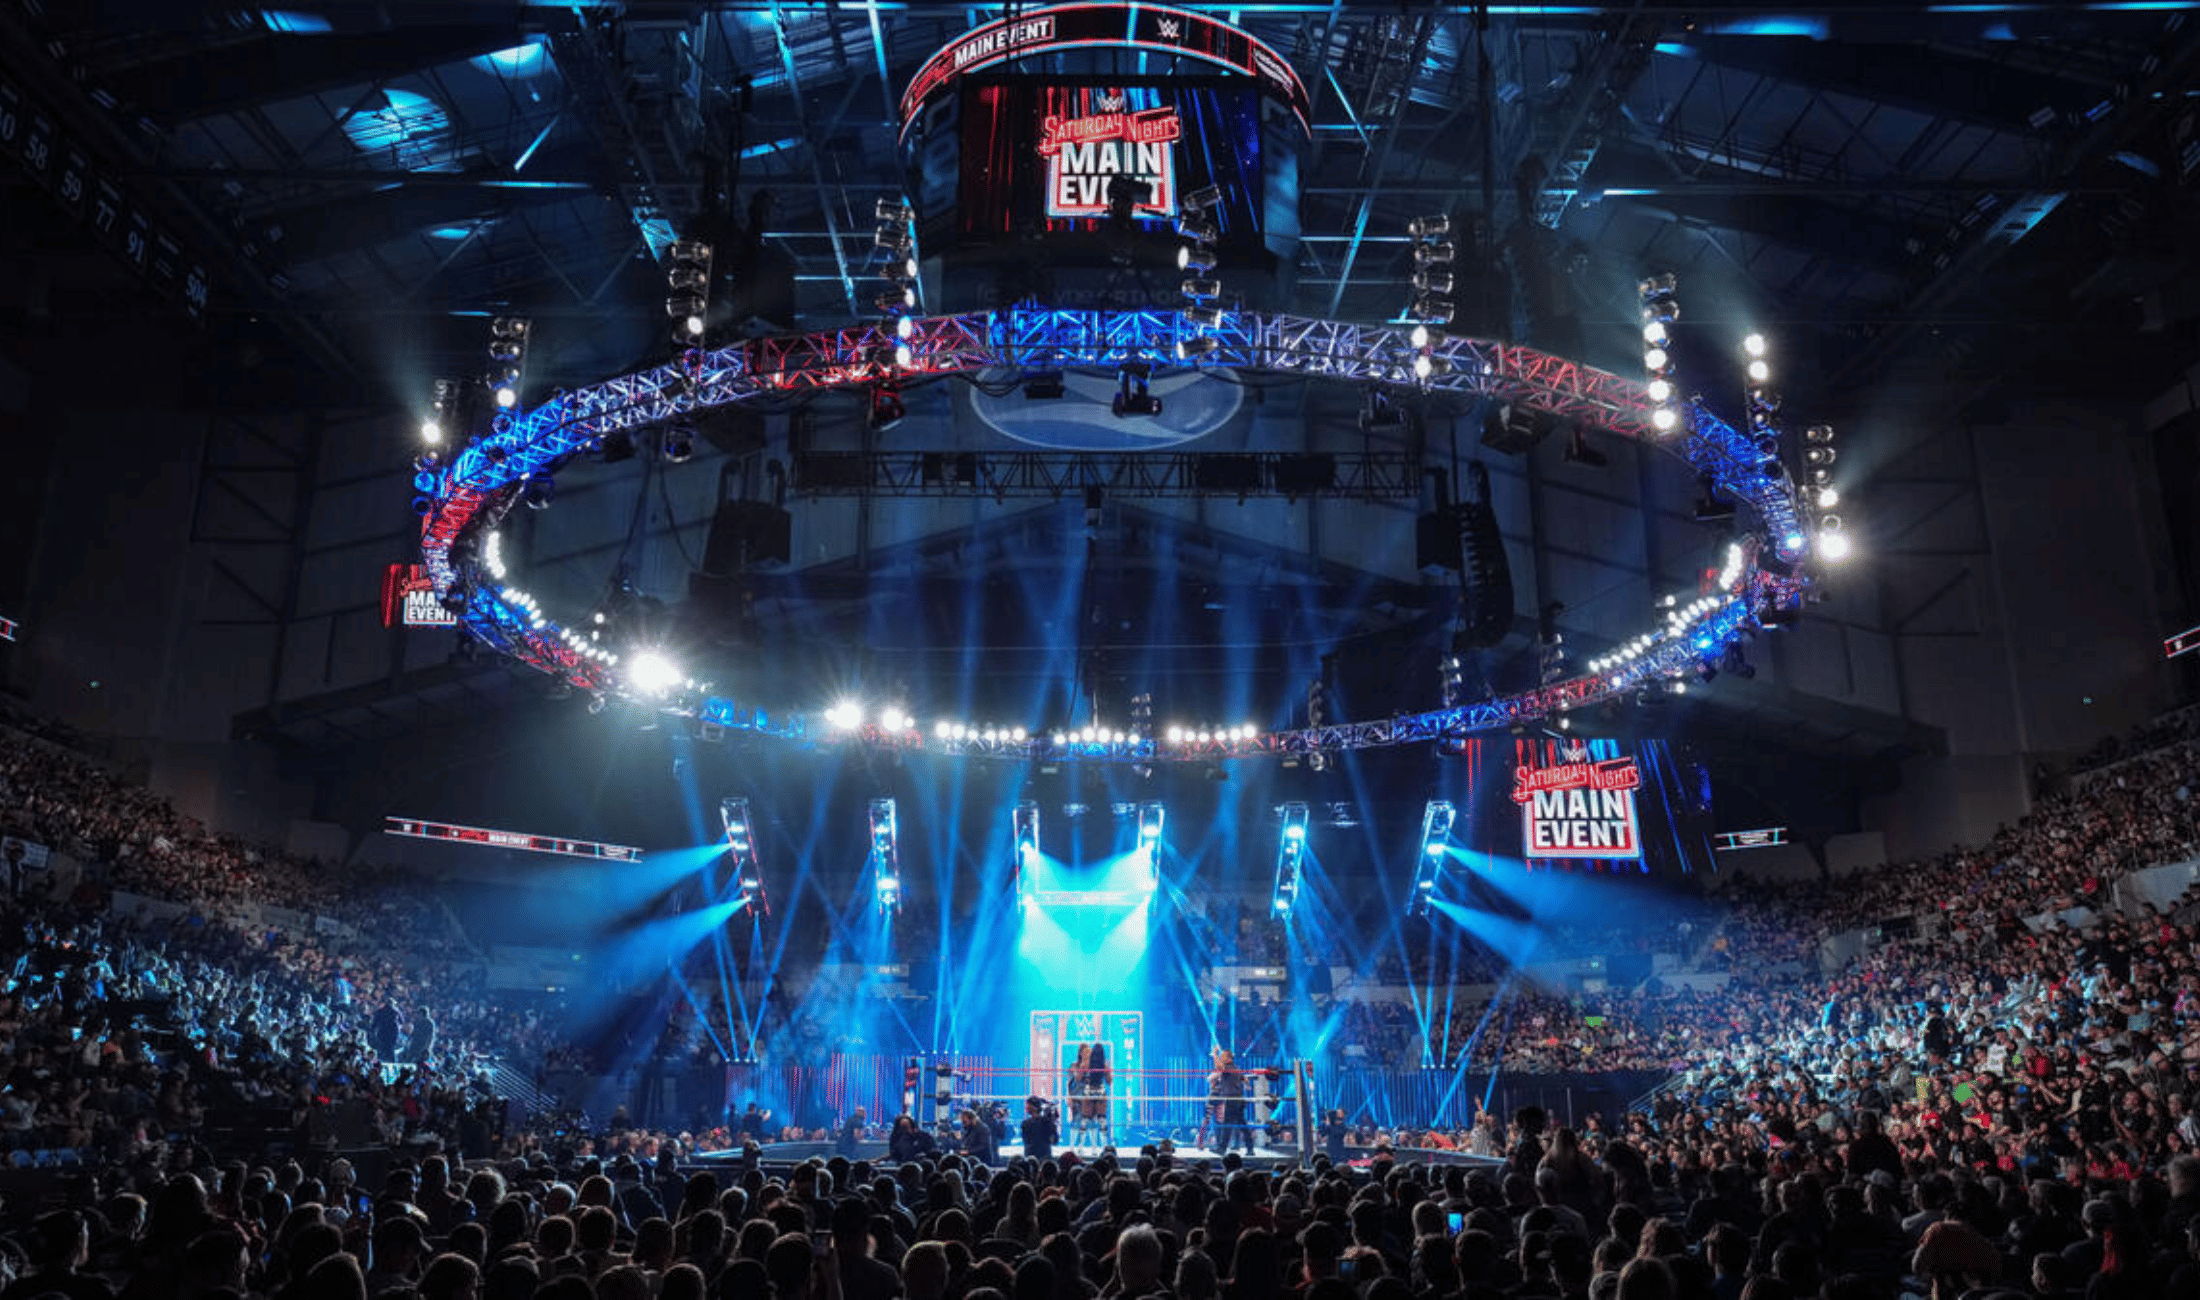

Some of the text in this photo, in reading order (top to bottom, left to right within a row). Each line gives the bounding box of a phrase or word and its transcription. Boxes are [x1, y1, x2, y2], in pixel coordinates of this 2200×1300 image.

[955, 20, 1050, 69] MAIN EVENT
[0, 105, 16, 142] 0
[1040, 109, 1181, 150] SATURDAY NIGHTS
[1061, 142, 1161, 174] MAIN
[1060, 176, 1164, 205] EVT
[1513, 758, 1640, 798] SATURDAY NIGHTS
[1534, 789, 1625, 819] MAIN
[1535, 820, 1630, 847] EVENT
